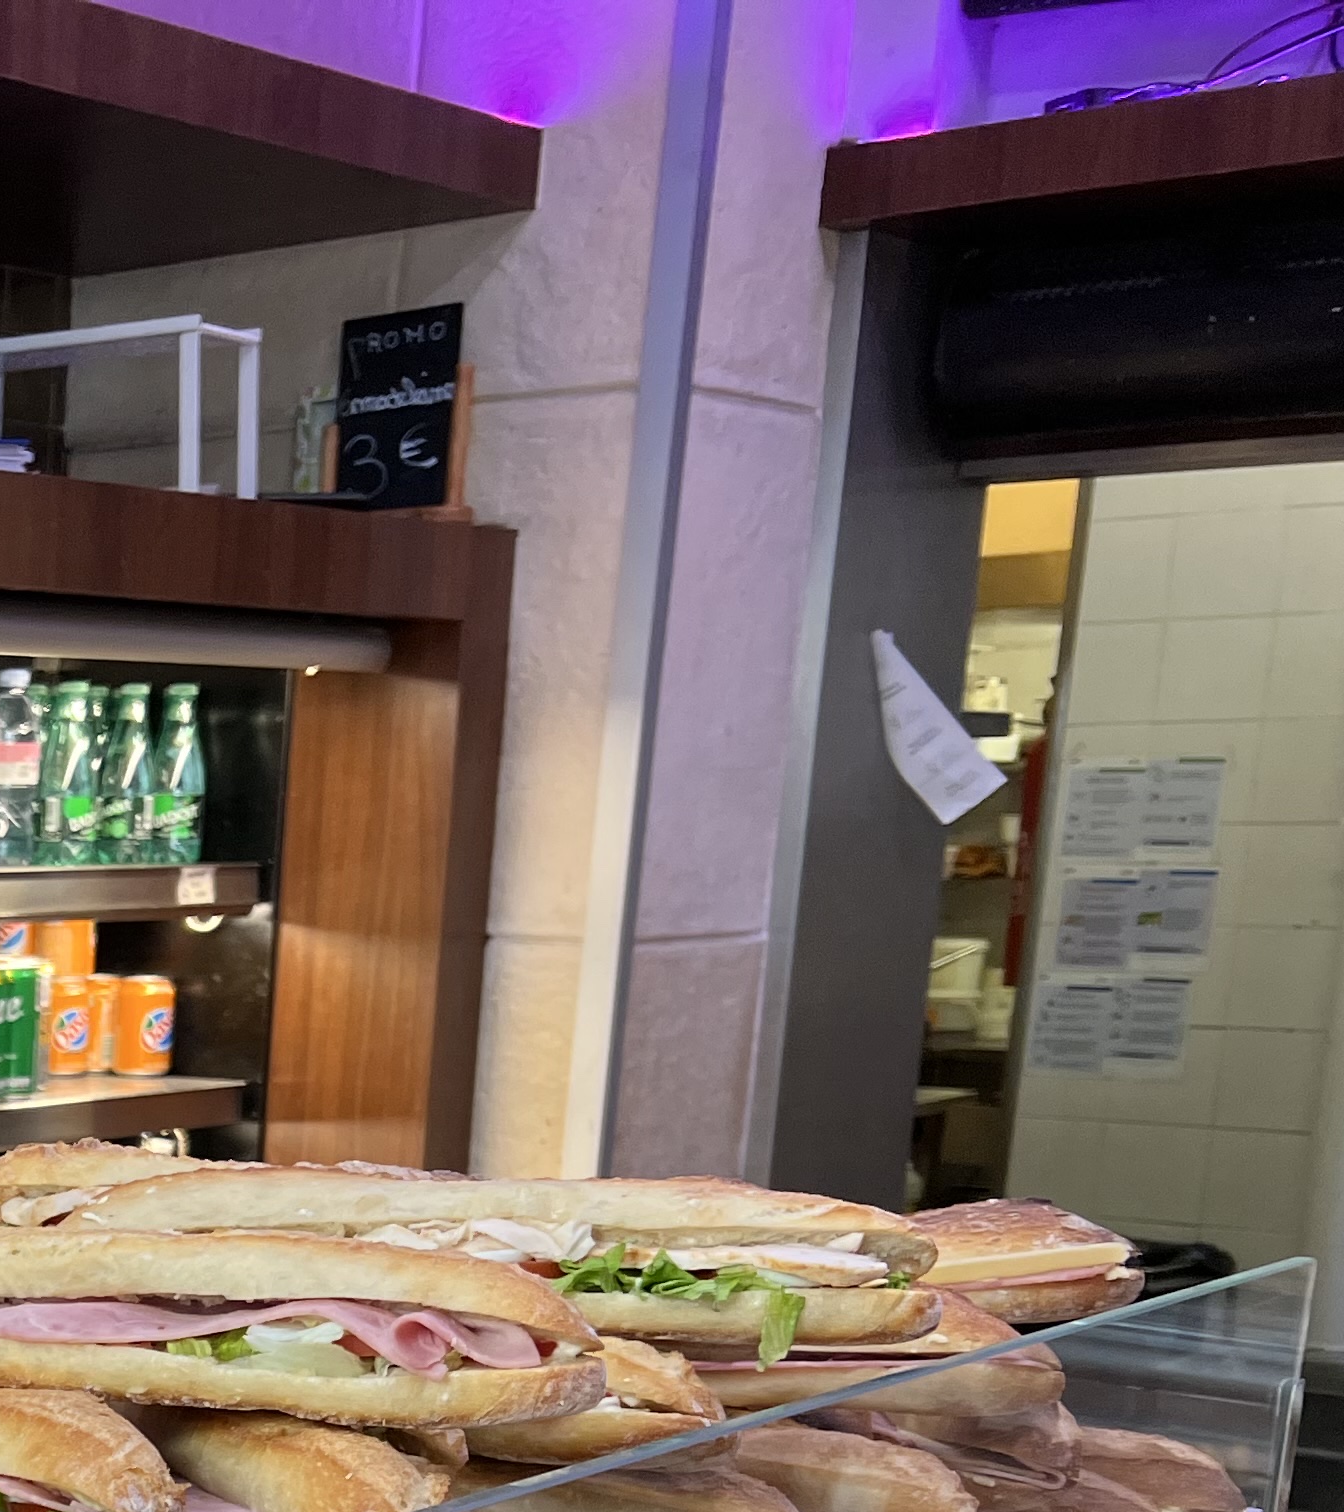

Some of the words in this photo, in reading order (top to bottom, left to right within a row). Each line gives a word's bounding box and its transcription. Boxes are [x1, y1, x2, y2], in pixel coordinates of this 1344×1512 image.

[348, 321, 447, 381] PROMO
[344, 434, 389, 499] 3
[399, 423, 439, 468] €
